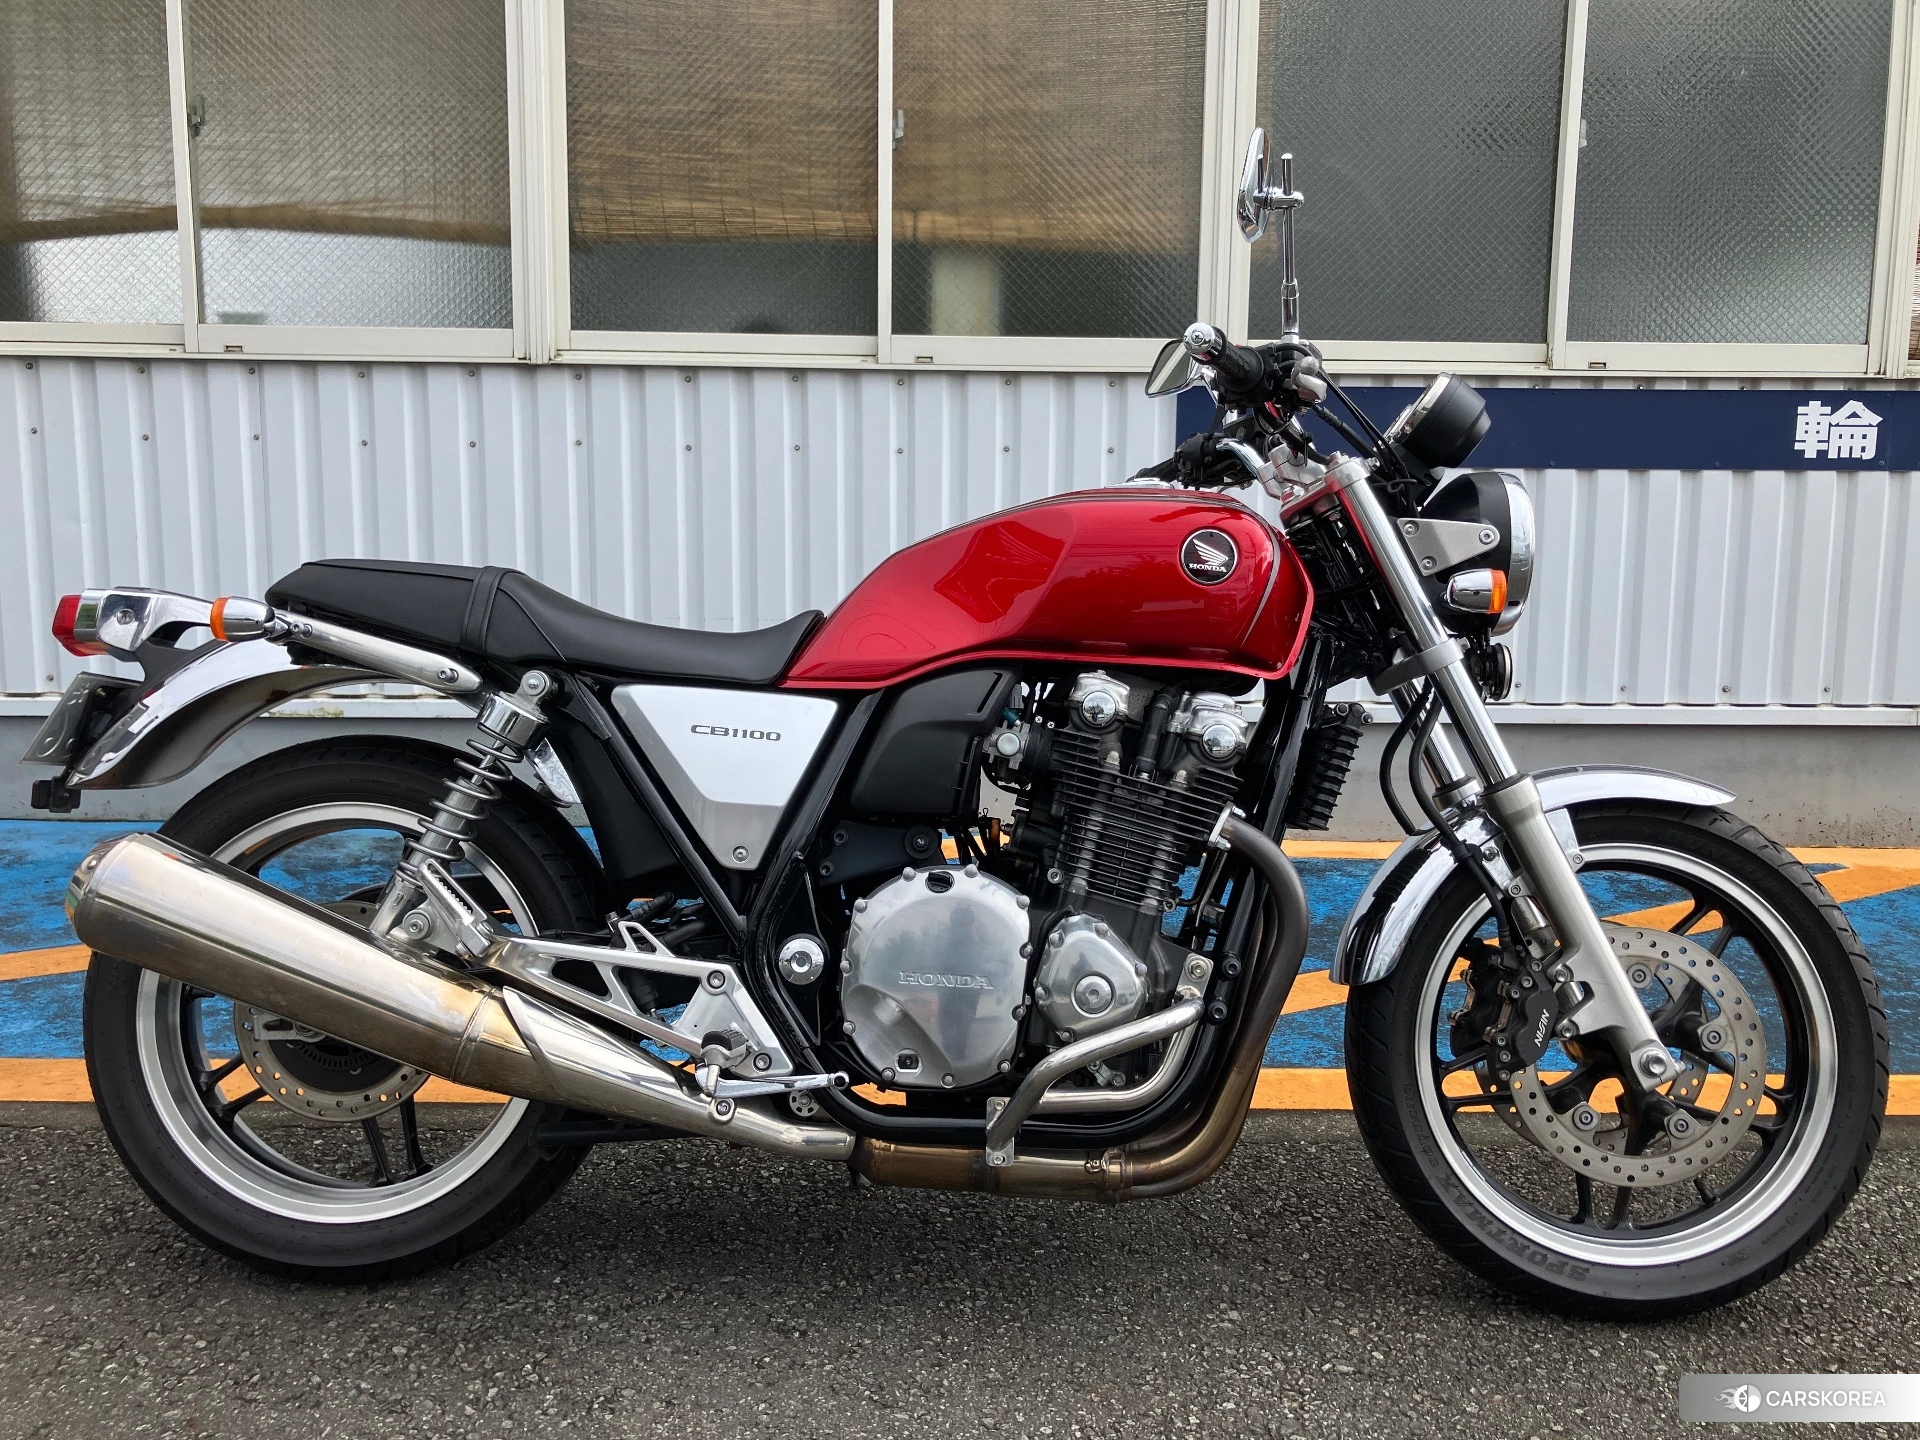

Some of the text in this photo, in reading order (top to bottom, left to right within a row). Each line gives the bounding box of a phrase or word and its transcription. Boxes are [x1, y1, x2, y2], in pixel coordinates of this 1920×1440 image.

[1794, 399, 1884, 460] 輪
[1188, 563, 1227, 573] HONDA
[690, 724, 782, 742] CB1100
[898, 970, 995, 990] HONDA
[1534, 1008, 1550, 1048] NISSIN
[1435, 1172, 1591, 1282] SPORTMAX
